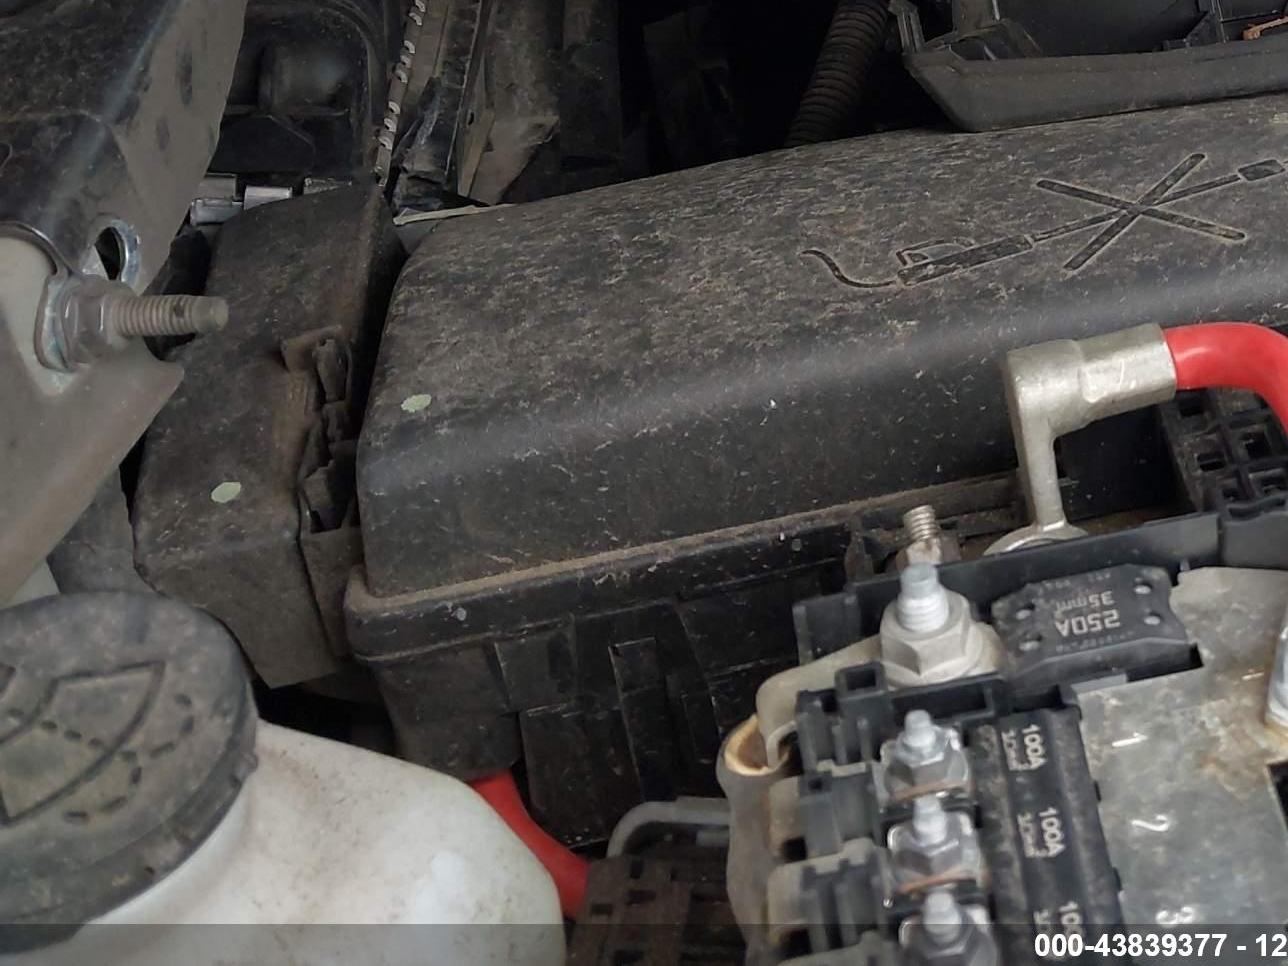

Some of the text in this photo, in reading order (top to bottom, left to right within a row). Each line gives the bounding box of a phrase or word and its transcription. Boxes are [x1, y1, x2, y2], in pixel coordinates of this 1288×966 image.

[1054, 609, 1121, 637] 250A
[1022, 723, 1048, 770] 100A
[1039, 806, 1067, 858] 100A
